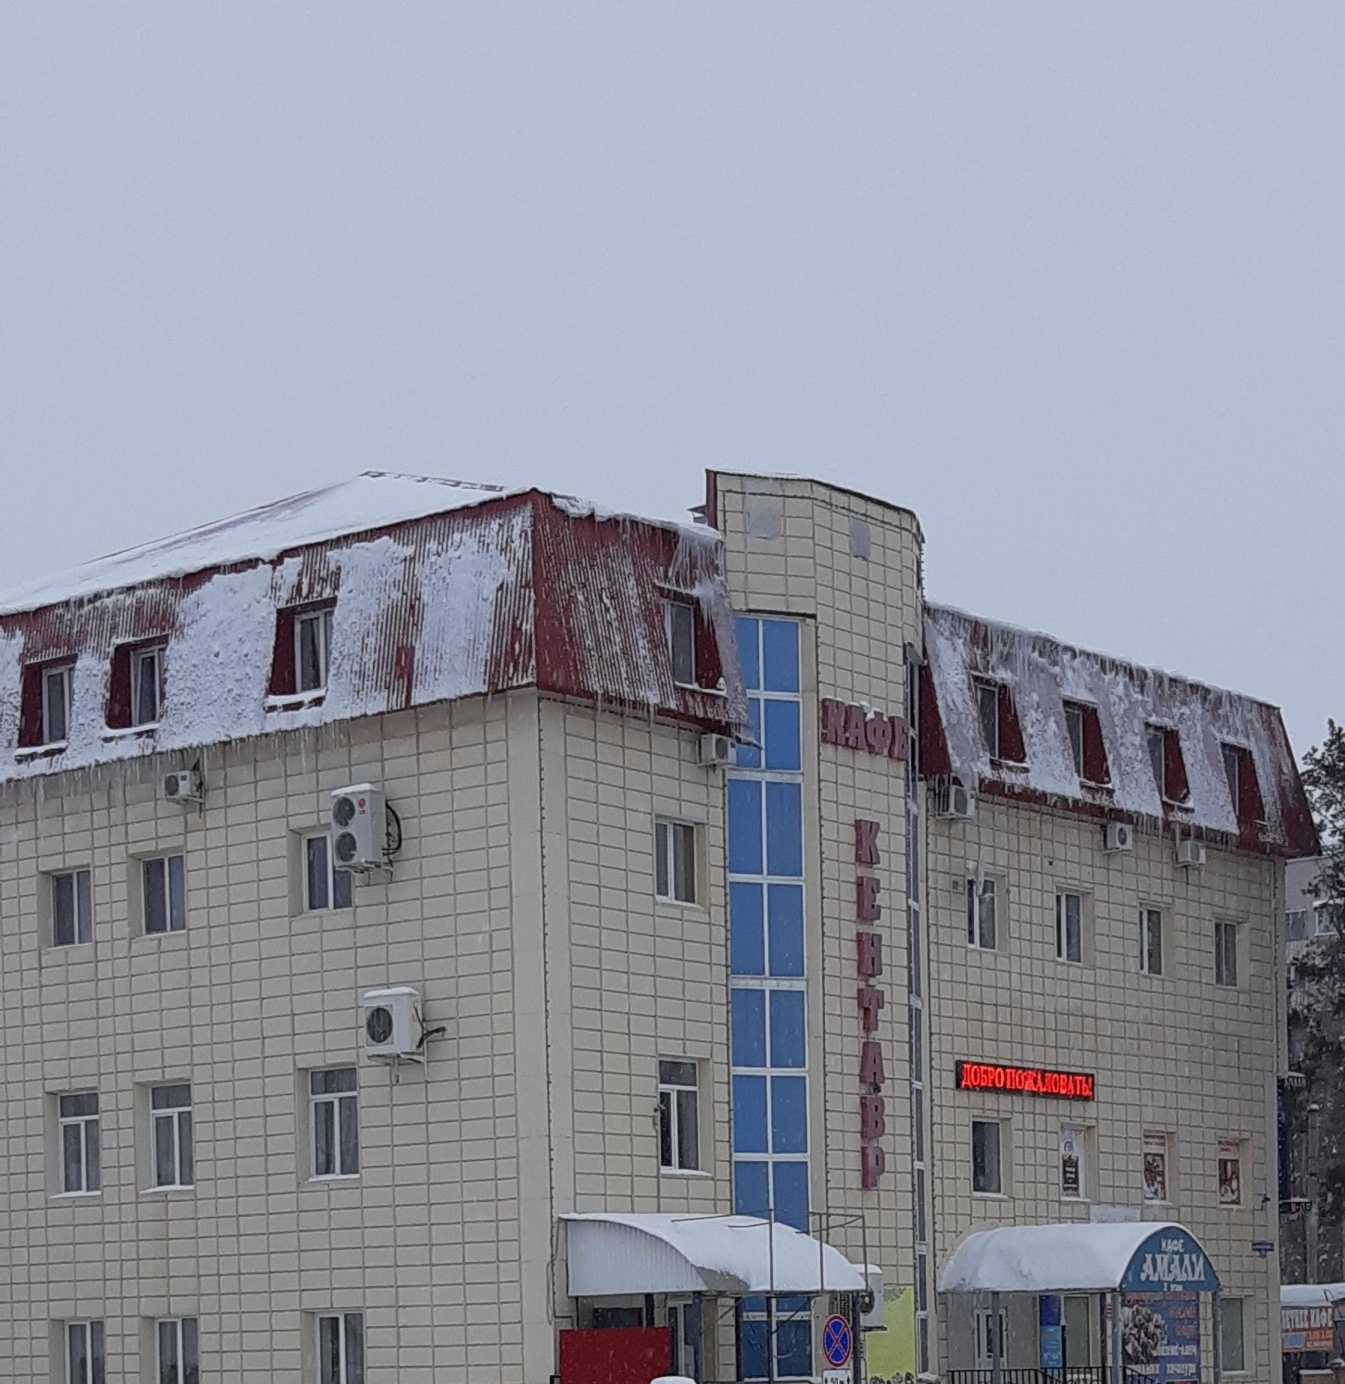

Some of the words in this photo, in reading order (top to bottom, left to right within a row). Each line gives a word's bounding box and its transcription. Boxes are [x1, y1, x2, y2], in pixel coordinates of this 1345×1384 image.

[820, 699, 911, 761] КАФЕ
[855, 819, 886, 1192] КЕНТАВР
[961, 1063, 1004, 1089] ДОБРО
[1005, 1068, 1093, 1097] ПОЖАЛОВАТЬ!
[1161, 1239, 1184, 1252] КАФЕ
[1140, 1253, 1205, 1281] АМАЛИ
